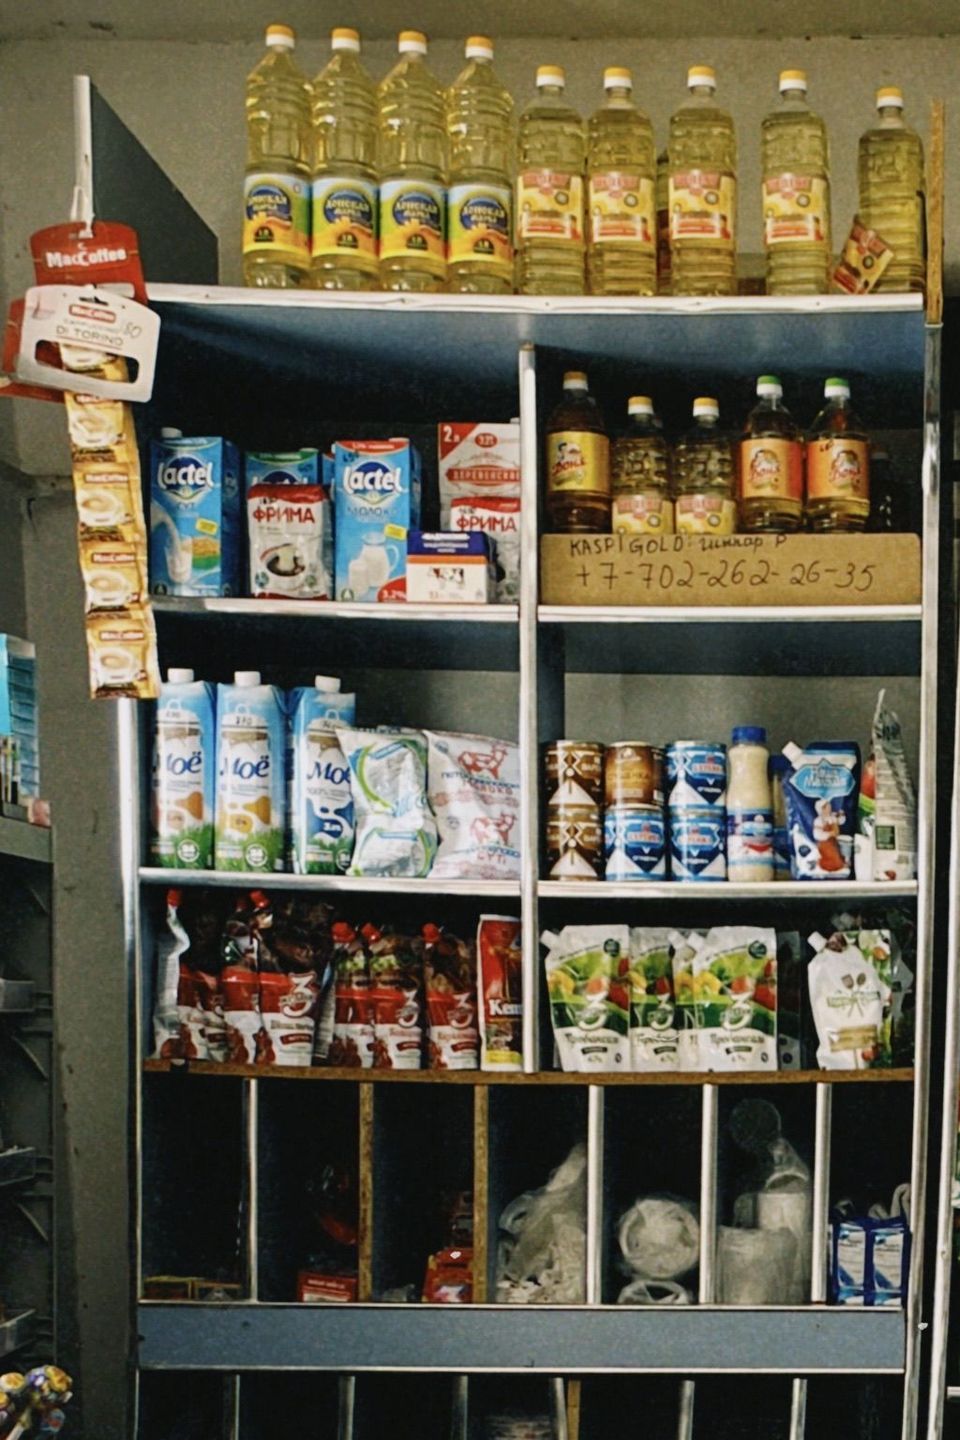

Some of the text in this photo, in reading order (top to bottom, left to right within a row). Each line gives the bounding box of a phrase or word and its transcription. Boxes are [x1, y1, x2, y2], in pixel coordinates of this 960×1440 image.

[45, 248, 128, 268] MacCoffee
[253, 504, 315, 524] ФРИМА
[456, 515, 517, 532] ФРИМА
[628, 536, 685, 555] GOLD
